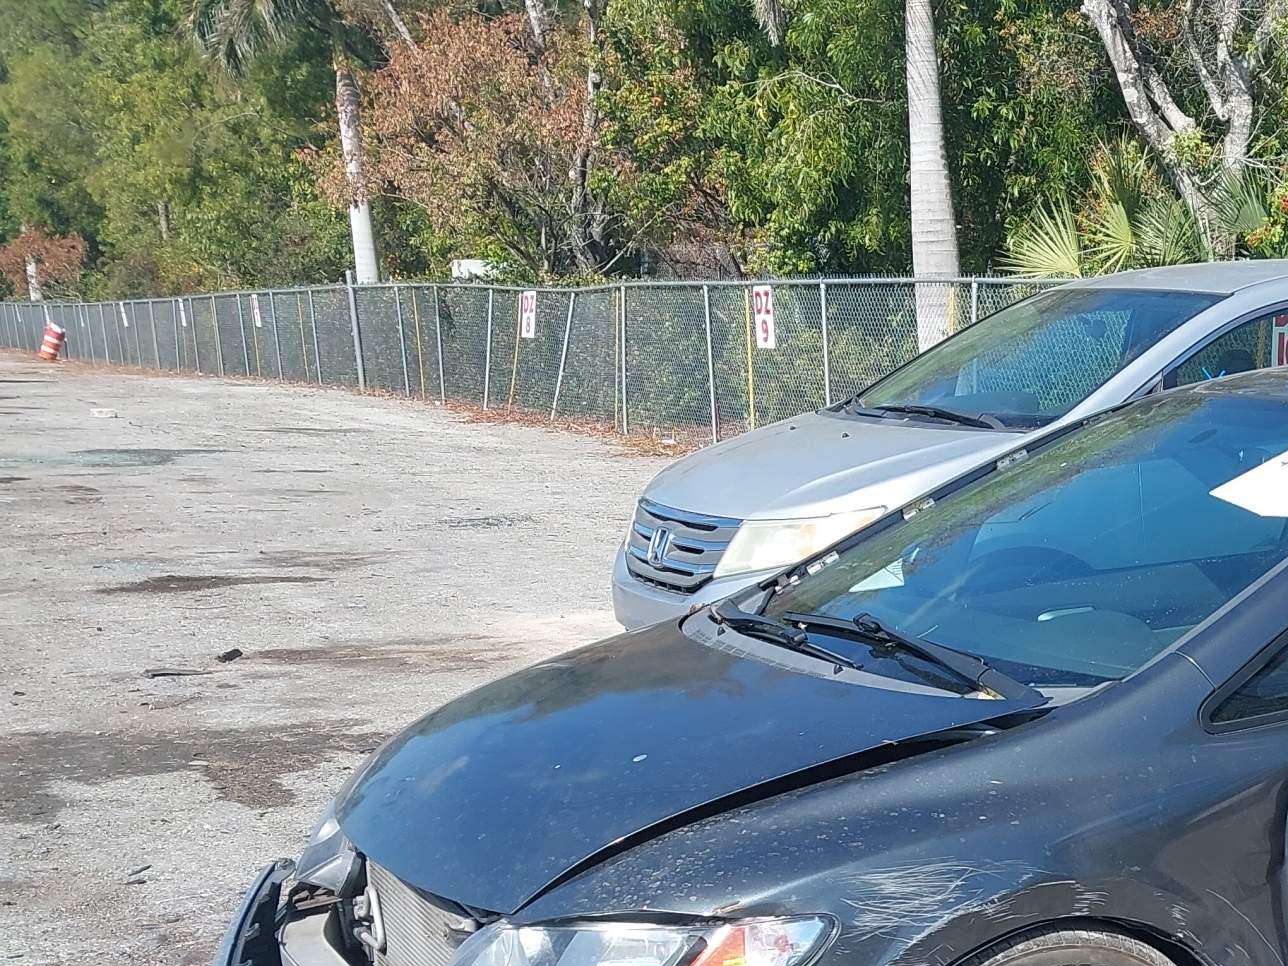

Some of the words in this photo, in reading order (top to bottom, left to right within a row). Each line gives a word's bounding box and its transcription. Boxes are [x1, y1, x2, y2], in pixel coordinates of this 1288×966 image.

[523, 295, 535, 313] DZ
[754, 290, 771, 314] DZ
[525, 315, 531, 333] 8
[761, 319, 769, 342] 9
